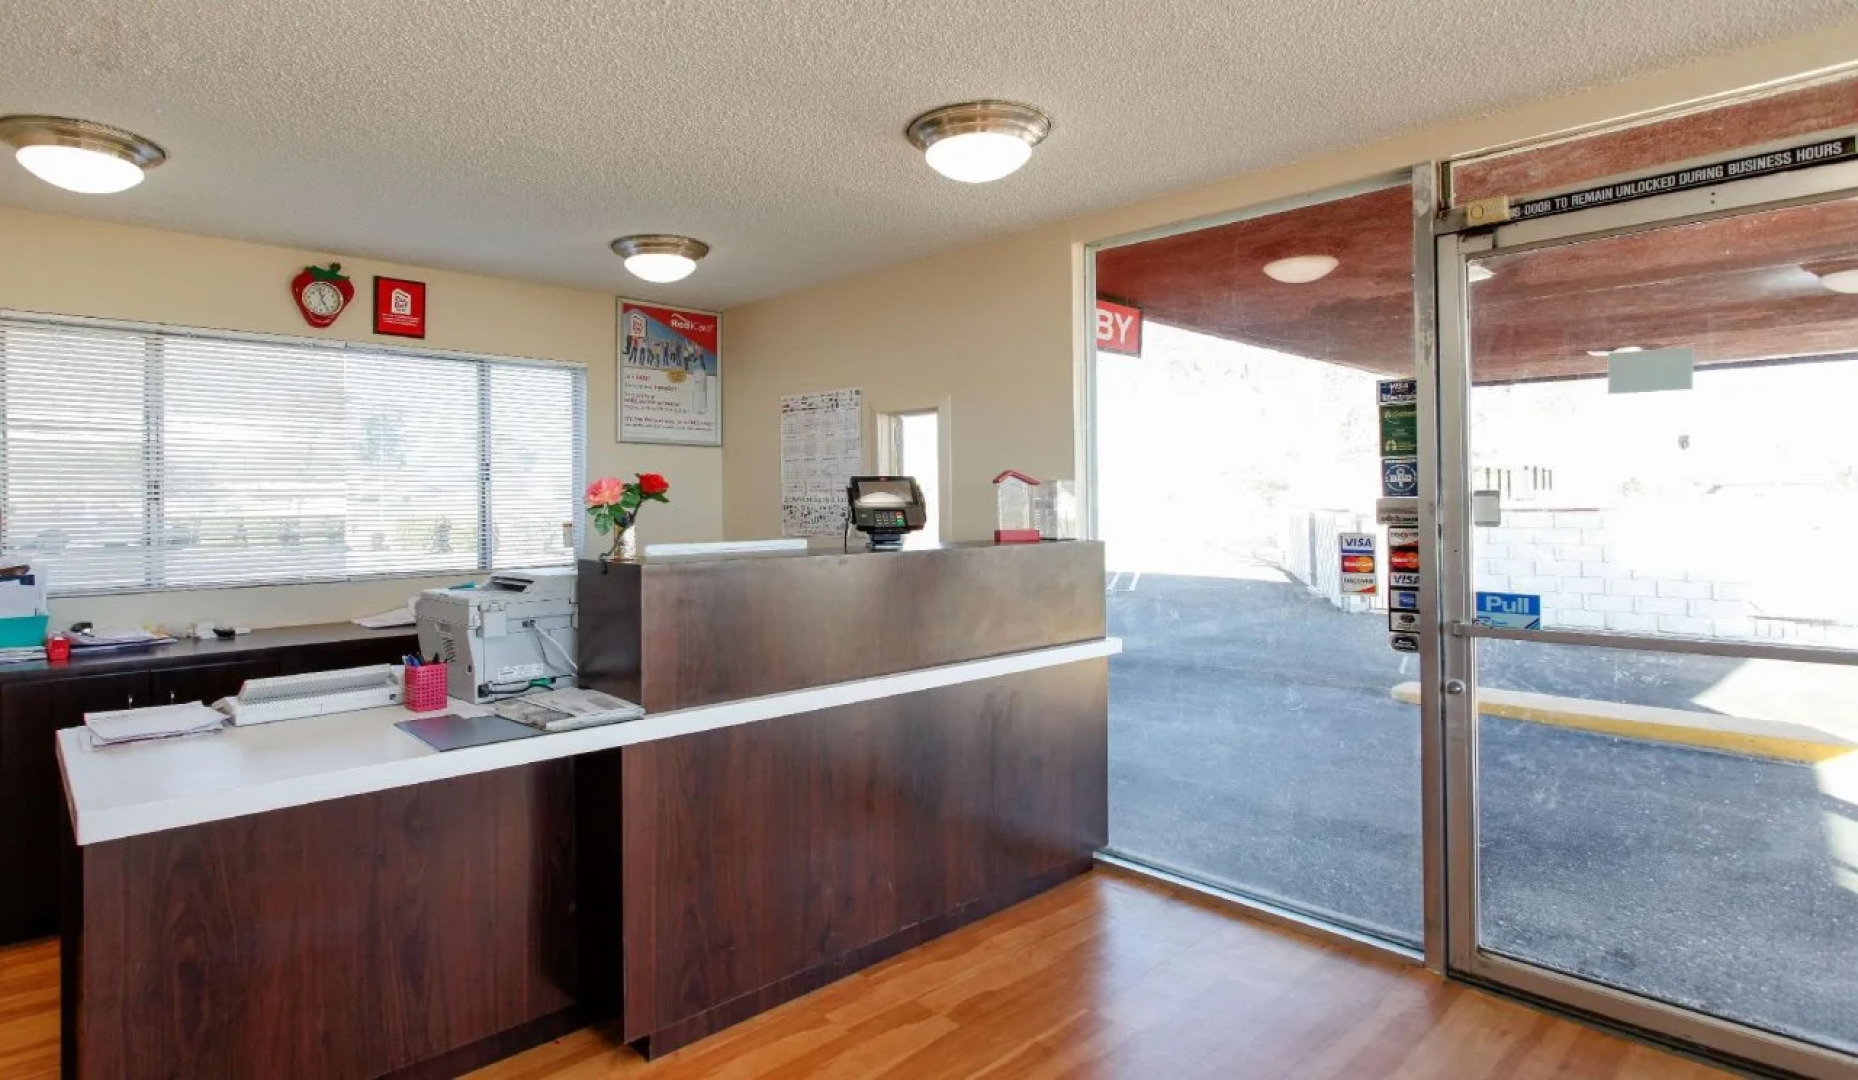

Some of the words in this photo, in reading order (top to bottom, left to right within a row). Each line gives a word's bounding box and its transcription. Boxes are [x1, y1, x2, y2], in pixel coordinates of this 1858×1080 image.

[1525, 201, 1551, 216] DOOR
[1555, 198, 1569, 210] TO
[1571, 191, 1613, 207] REMAIN
[1616, 175, 1676, 198] UNLOCKED
[1678, 165, 1724, 186] DURING
[1728, 152, 1792, 176] BUSINESS
[1796, 141, 1843, 162] HOURS
[1096, 308, 1134, 345] BY
[1345, 537, 1373, 548] VISA
[1394, 574, 1420, 584] VISA
[1485, 595, 1530, 614] Pull
